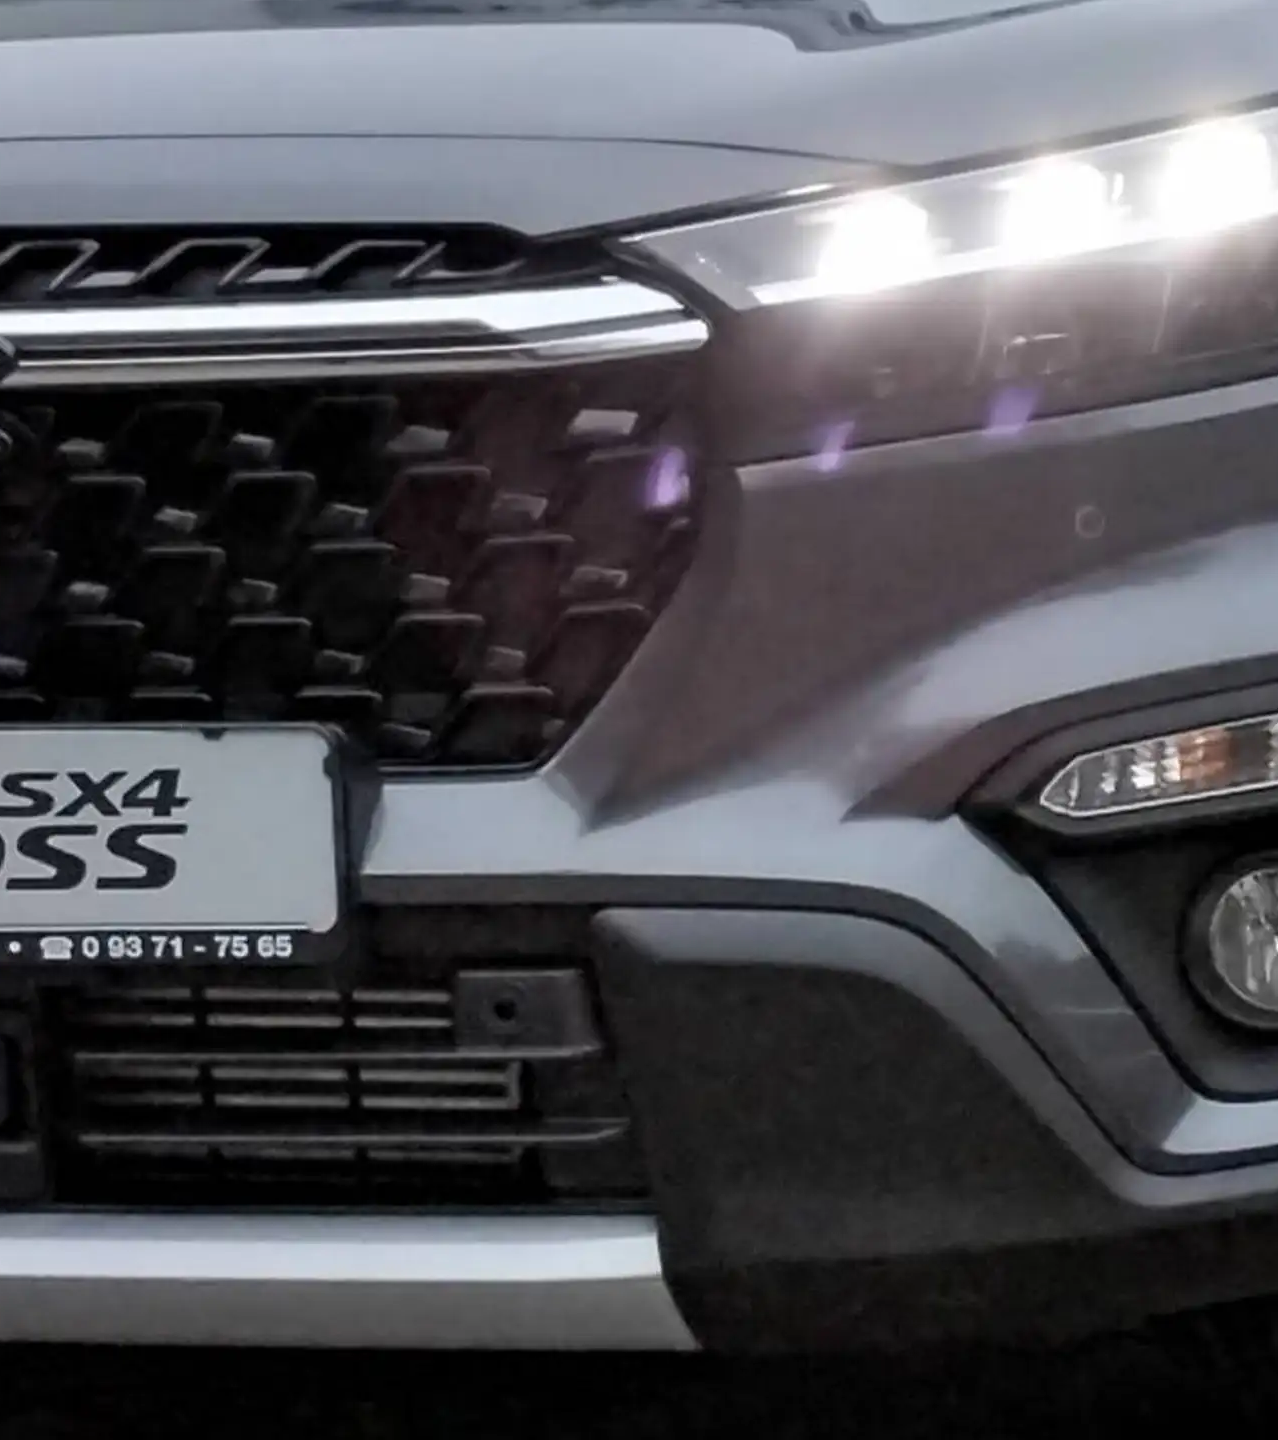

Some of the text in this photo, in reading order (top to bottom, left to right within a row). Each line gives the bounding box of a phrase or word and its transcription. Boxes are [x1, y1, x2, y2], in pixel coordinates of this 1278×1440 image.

[81, 935, 100, 959] 0
[107, 934, 144, 959] 93
[150, 935, 184, 959] 71
[213, 934, 250, 959] 75
[256, 934, 293, 959] 65
